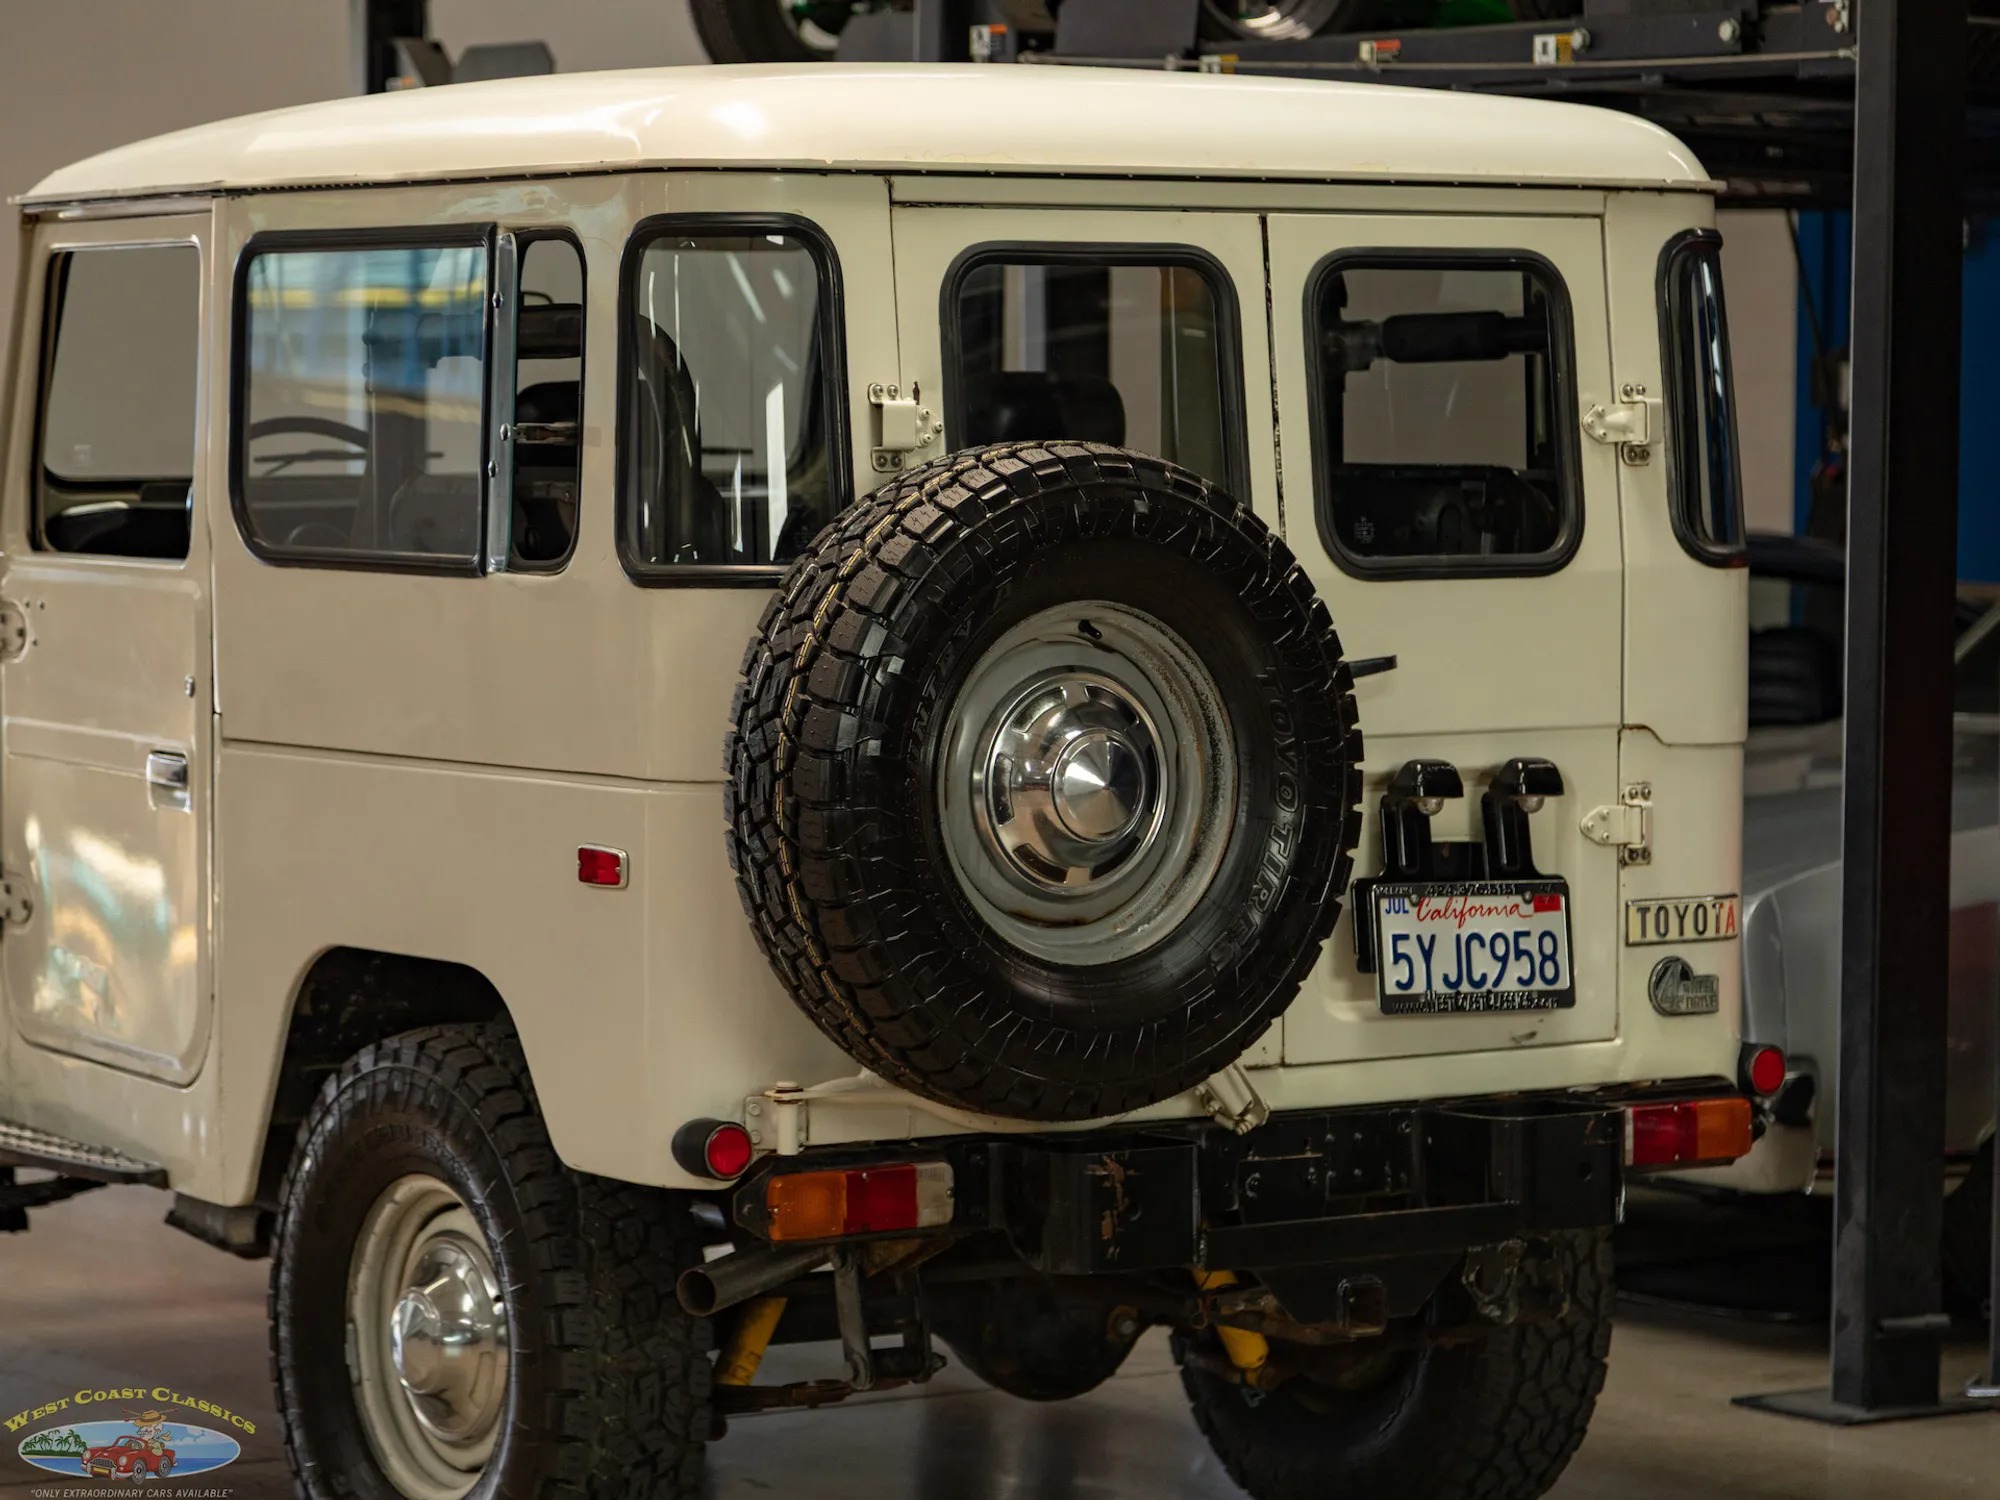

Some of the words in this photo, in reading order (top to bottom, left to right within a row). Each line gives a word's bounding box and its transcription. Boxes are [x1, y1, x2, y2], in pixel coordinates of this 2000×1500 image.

[1255, 665, 1299, 814] TOYO
[1207, 822, 1294, 977] TIRES
[1384, 898, 1410, 915] JUL
[1415, 896, 1533, 929] California
[1636, 901, 1737, 939] TOYOTA
[1391, 930, 1560, 991] 5YJC958
